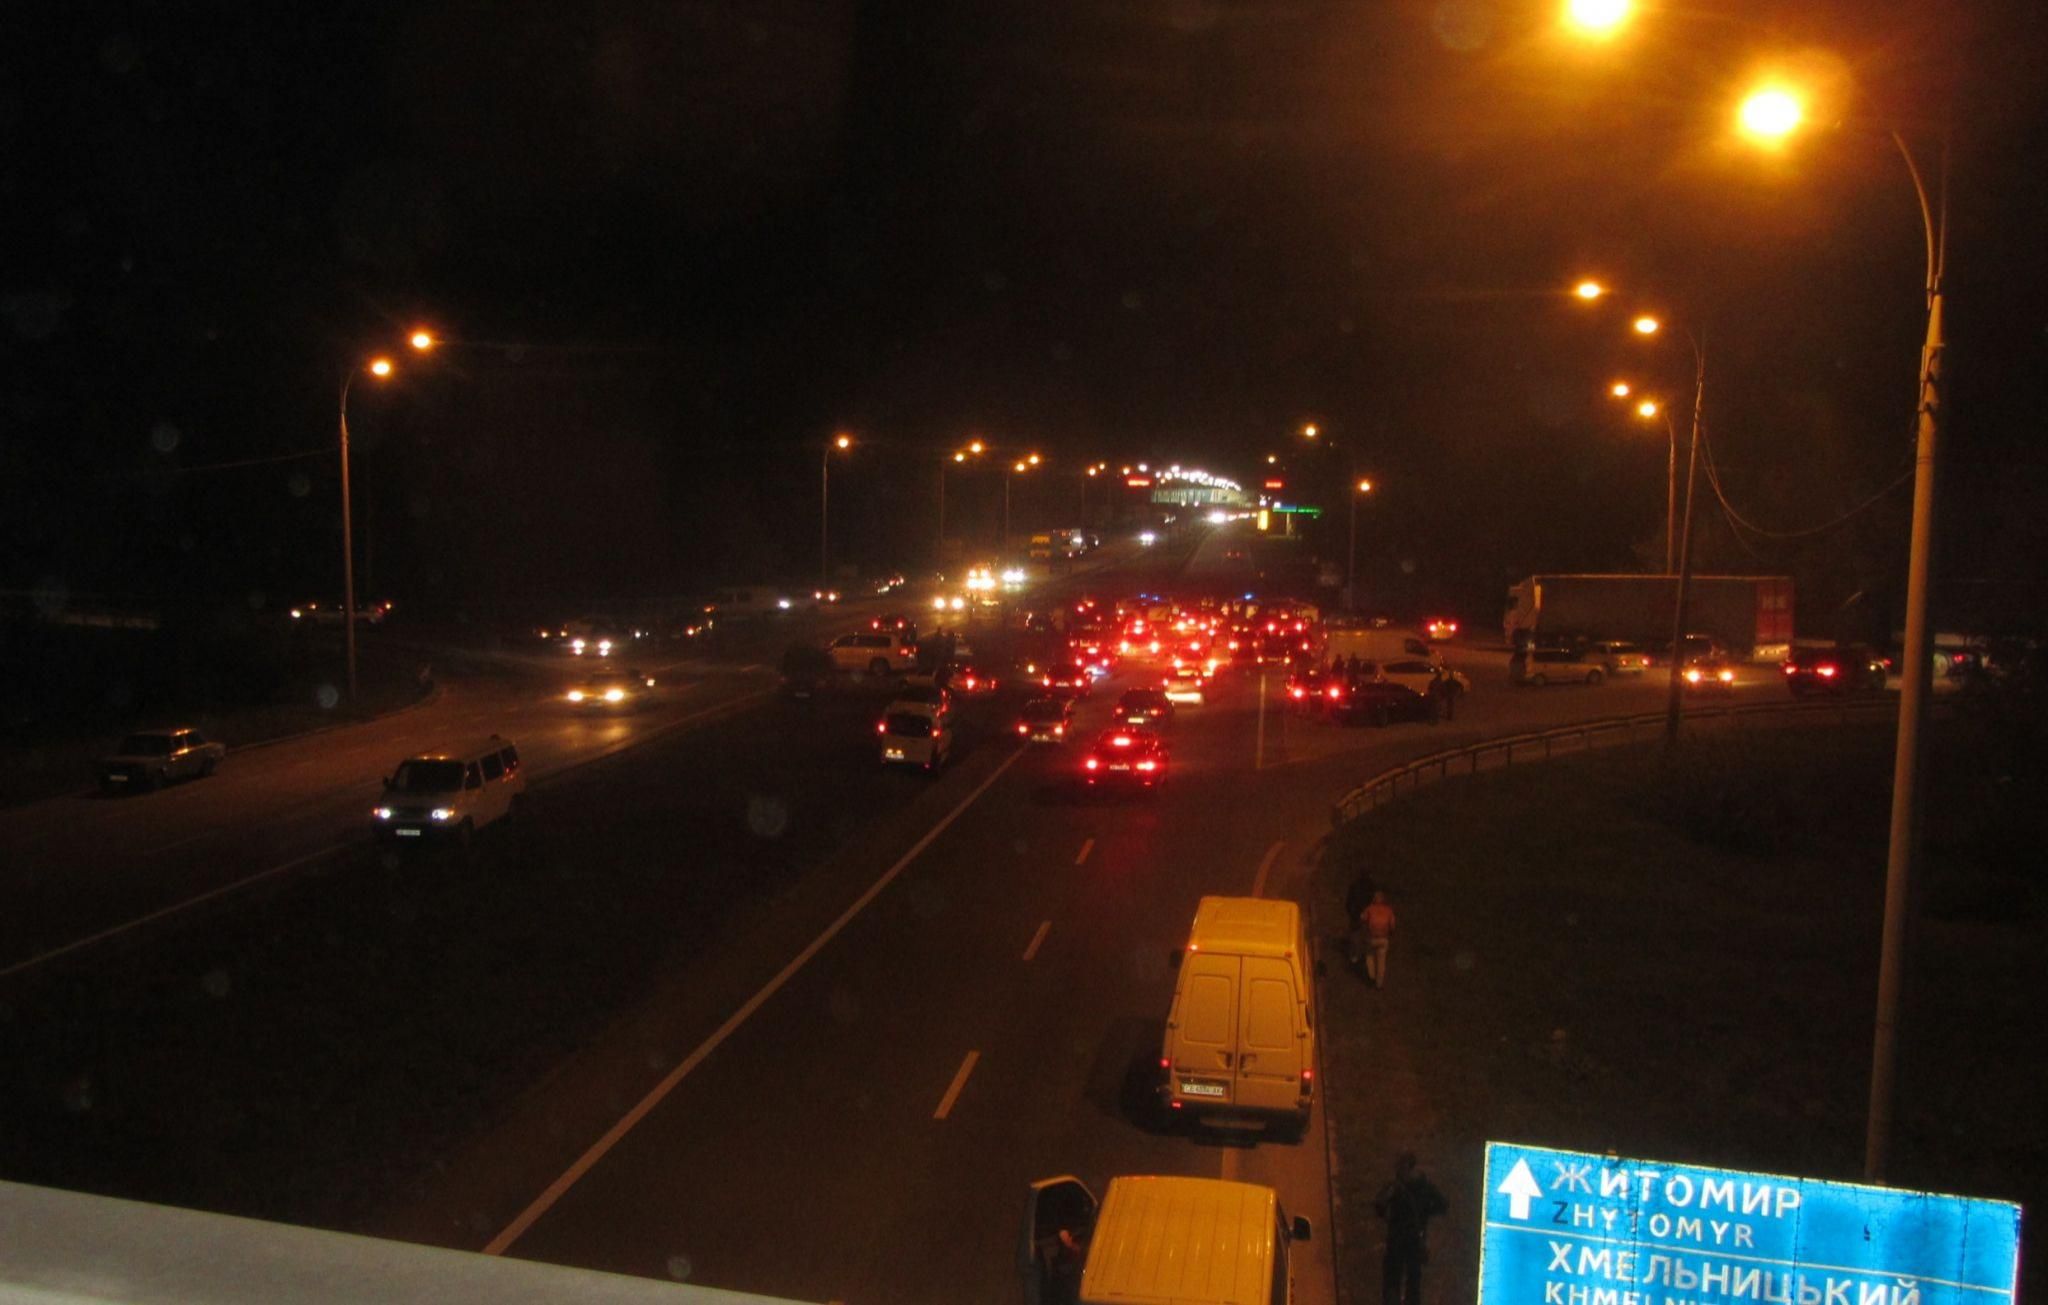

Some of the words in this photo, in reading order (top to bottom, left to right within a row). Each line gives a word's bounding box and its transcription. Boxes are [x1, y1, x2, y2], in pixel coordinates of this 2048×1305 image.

[1550, 1161, 1802, 1218] ЖИТОМИР
[1551, 1200, 1755, 1249] ZHYTOMYR
[1547, 1240, 1922, 1305] ХМЕЛЬНИЦЬКИЙ
